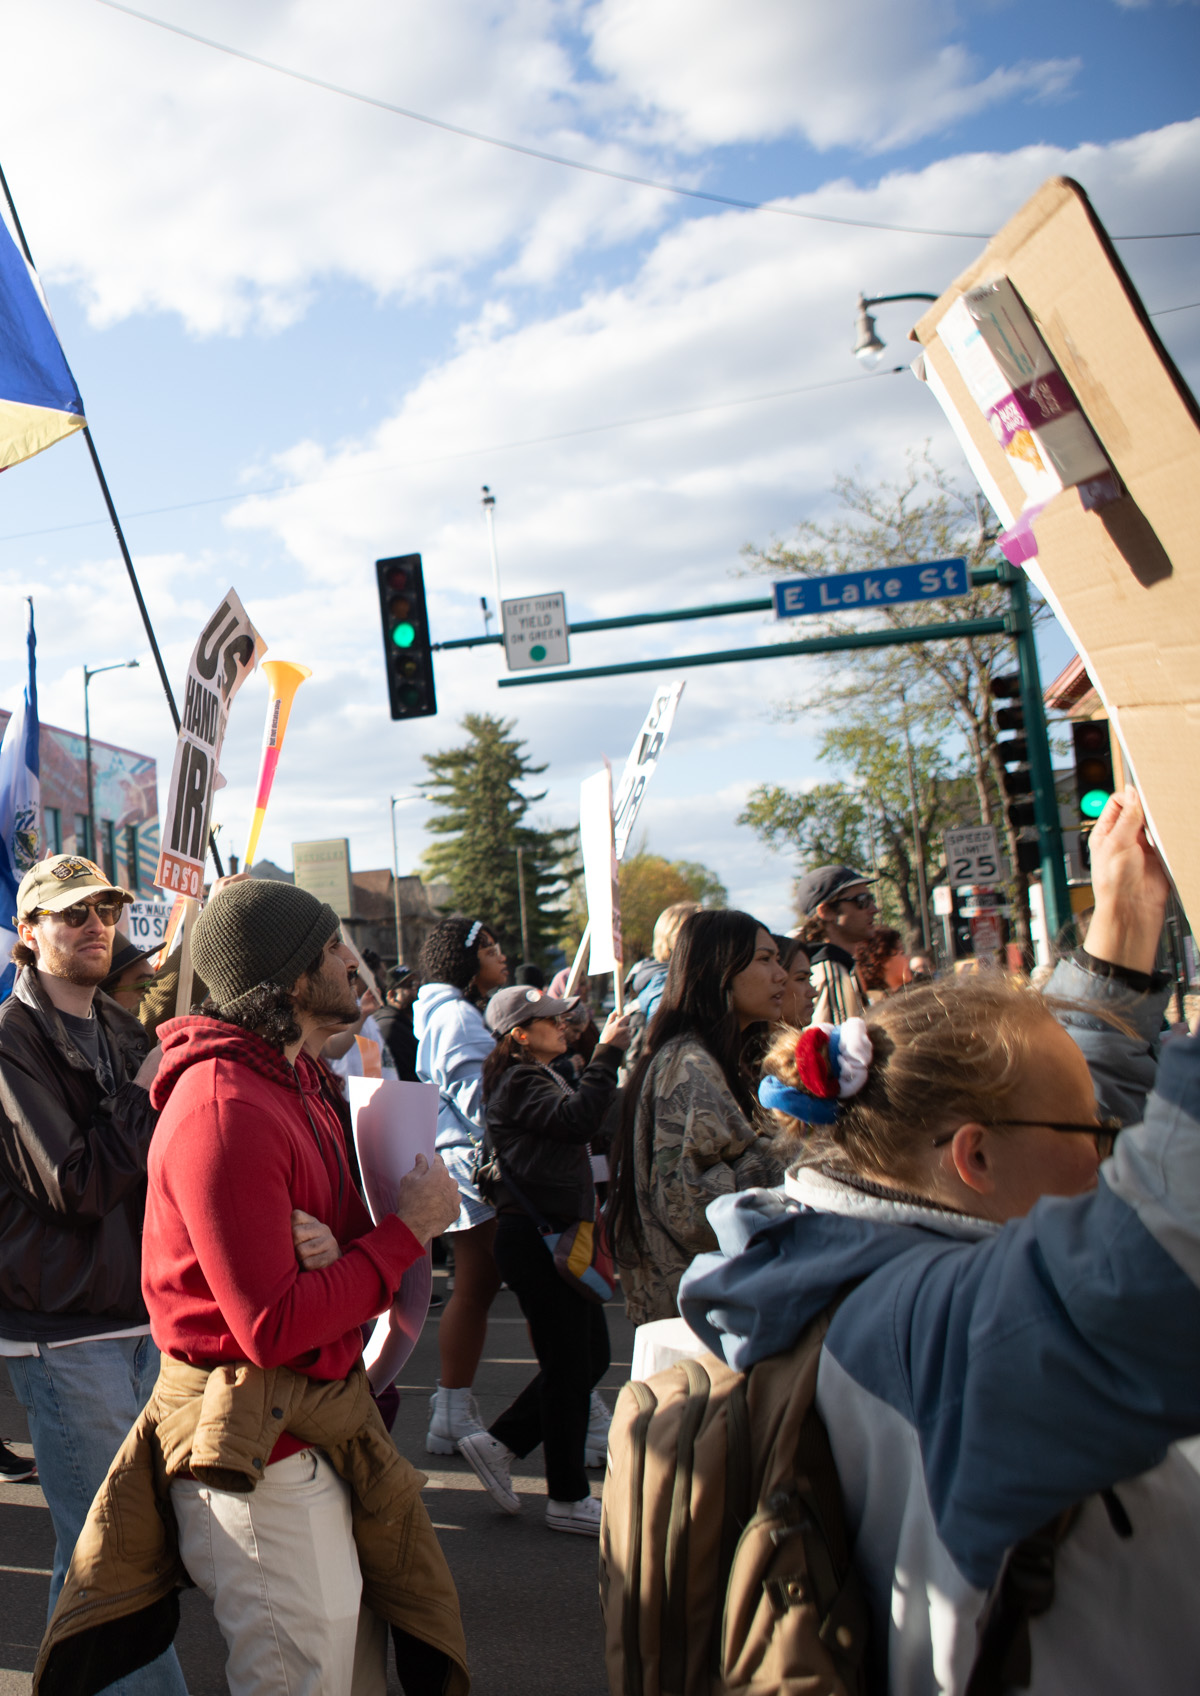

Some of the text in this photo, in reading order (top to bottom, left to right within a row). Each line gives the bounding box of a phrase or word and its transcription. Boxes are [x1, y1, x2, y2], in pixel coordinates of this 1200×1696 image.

[783, 566, 959, 611] E Lake St
[519, 613, 551, 628] YIELD
[529, 629, 562, 642] GREEN
[183, 674, 220, 747] HAND
[948, 832, 991, 845] SPEED
[954, 843, 989, 856] LIMIT
[954, 855, 997, 880] 25
[130, 904, 143, 914] WE
[146, 904, 166, 915] WALK
[130, 916, 150, 937] TO
